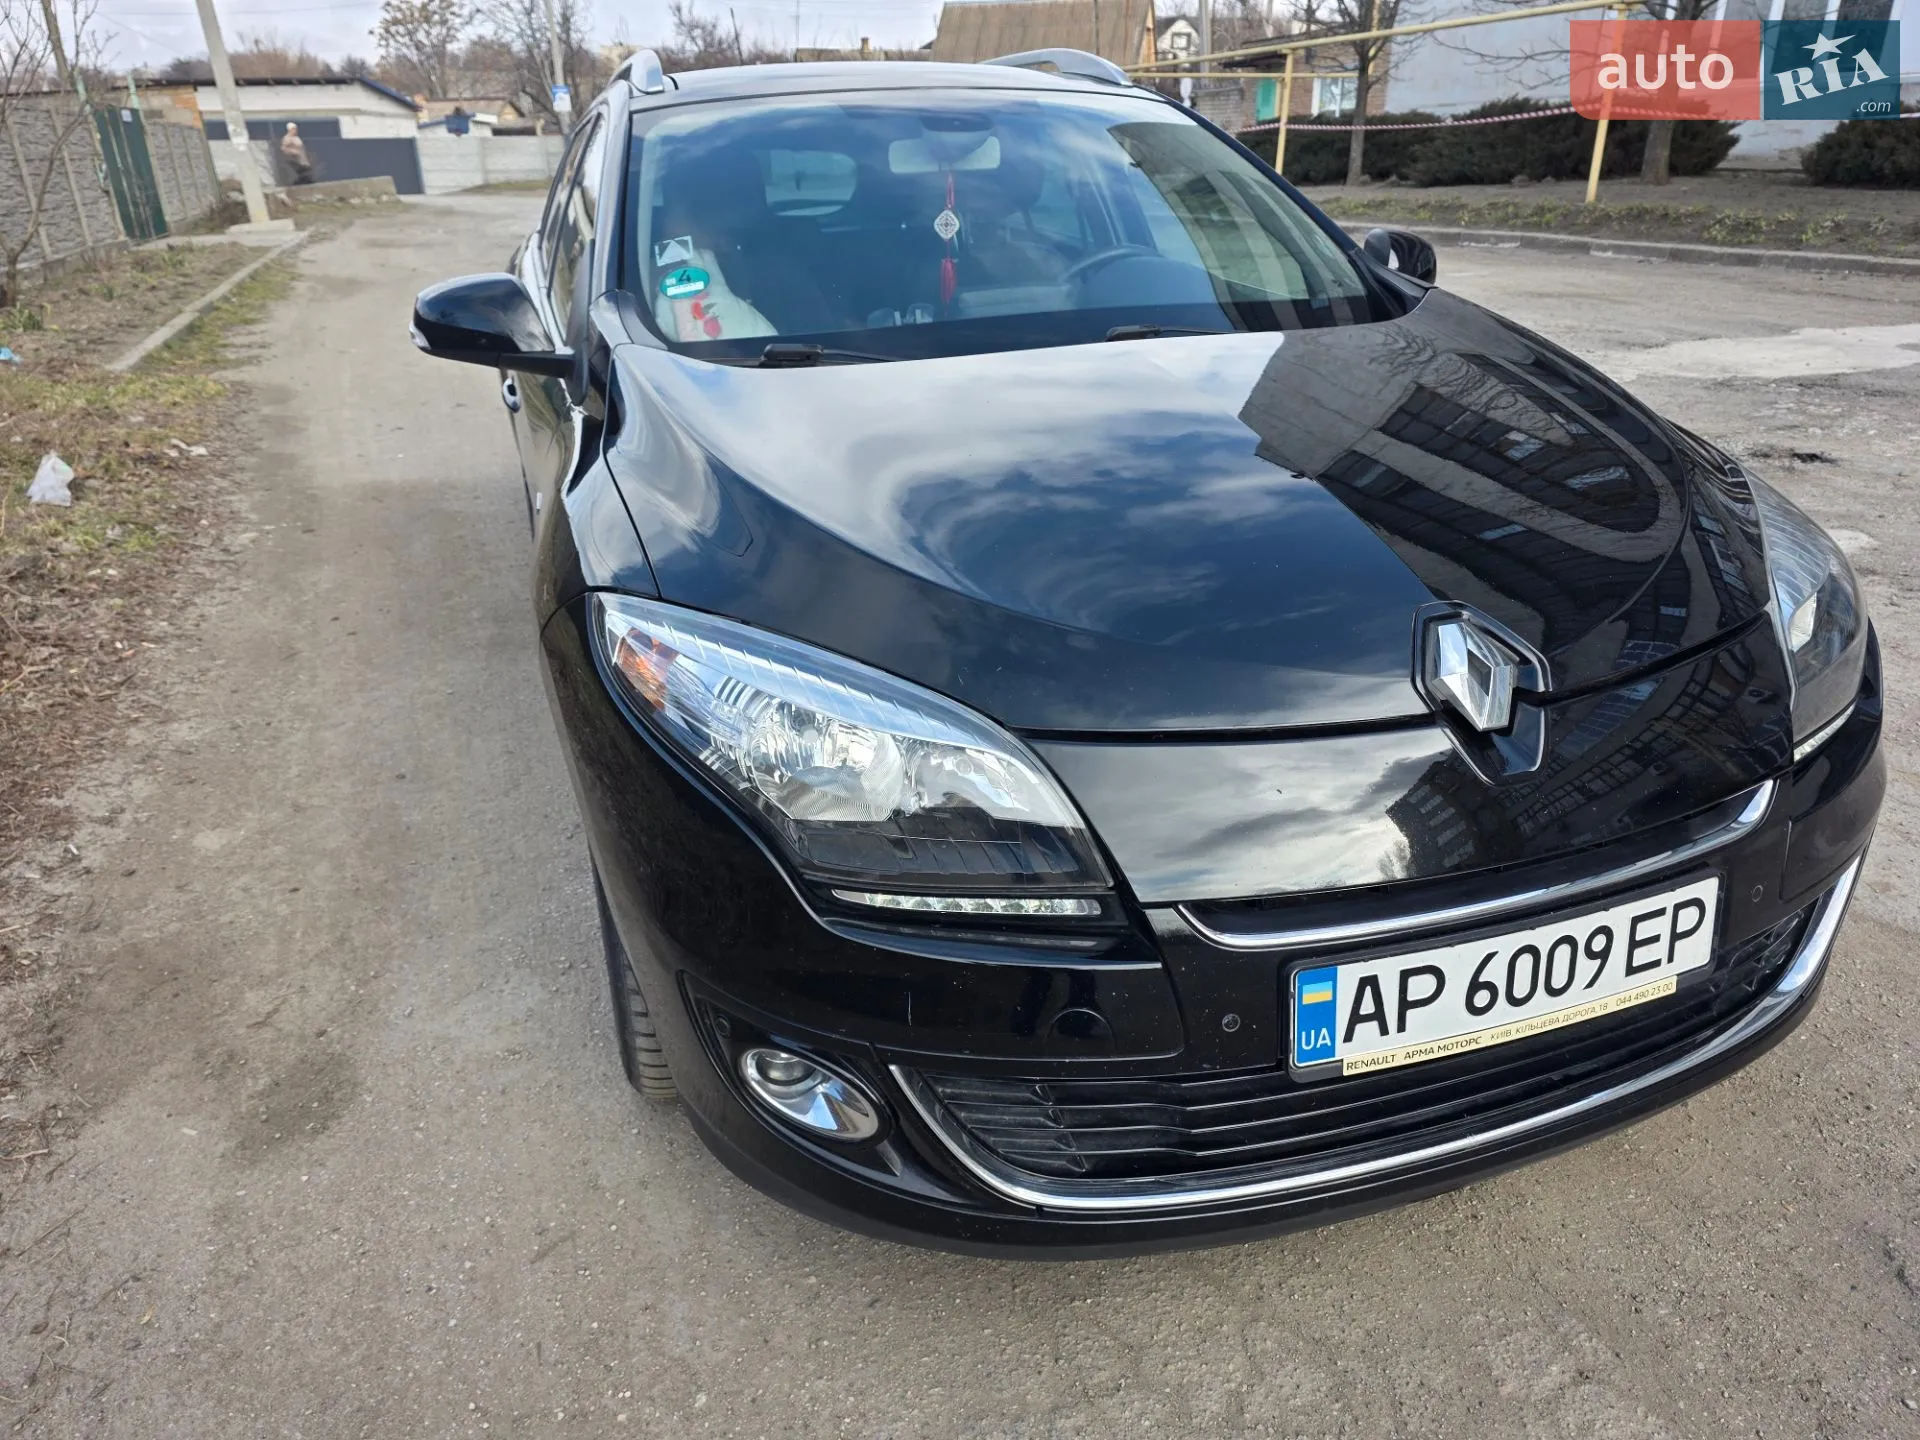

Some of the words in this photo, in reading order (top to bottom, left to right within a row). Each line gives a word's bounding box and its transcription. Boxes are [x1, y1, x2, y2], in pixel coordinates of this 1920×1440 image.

[678, 269, 691, 283] 4
[1343, 964, 1446, 1043] AP
[1464, 924, 1614, 1017] 6009
[1625, 896, 1707, 978] EP
[1301, 1027, 1332, 1051] UA
[1346, 1053, 1397, 1071] RENAULT
[1403, 1047, 1435, 1060] АРМА
[1437, 1036, 1482, 1053] МОТОРС
[1616, 995, 1632, 1007] 044
[1651, 985, 1661, 996] 23
[1662, 981, 1673, 992] 00
